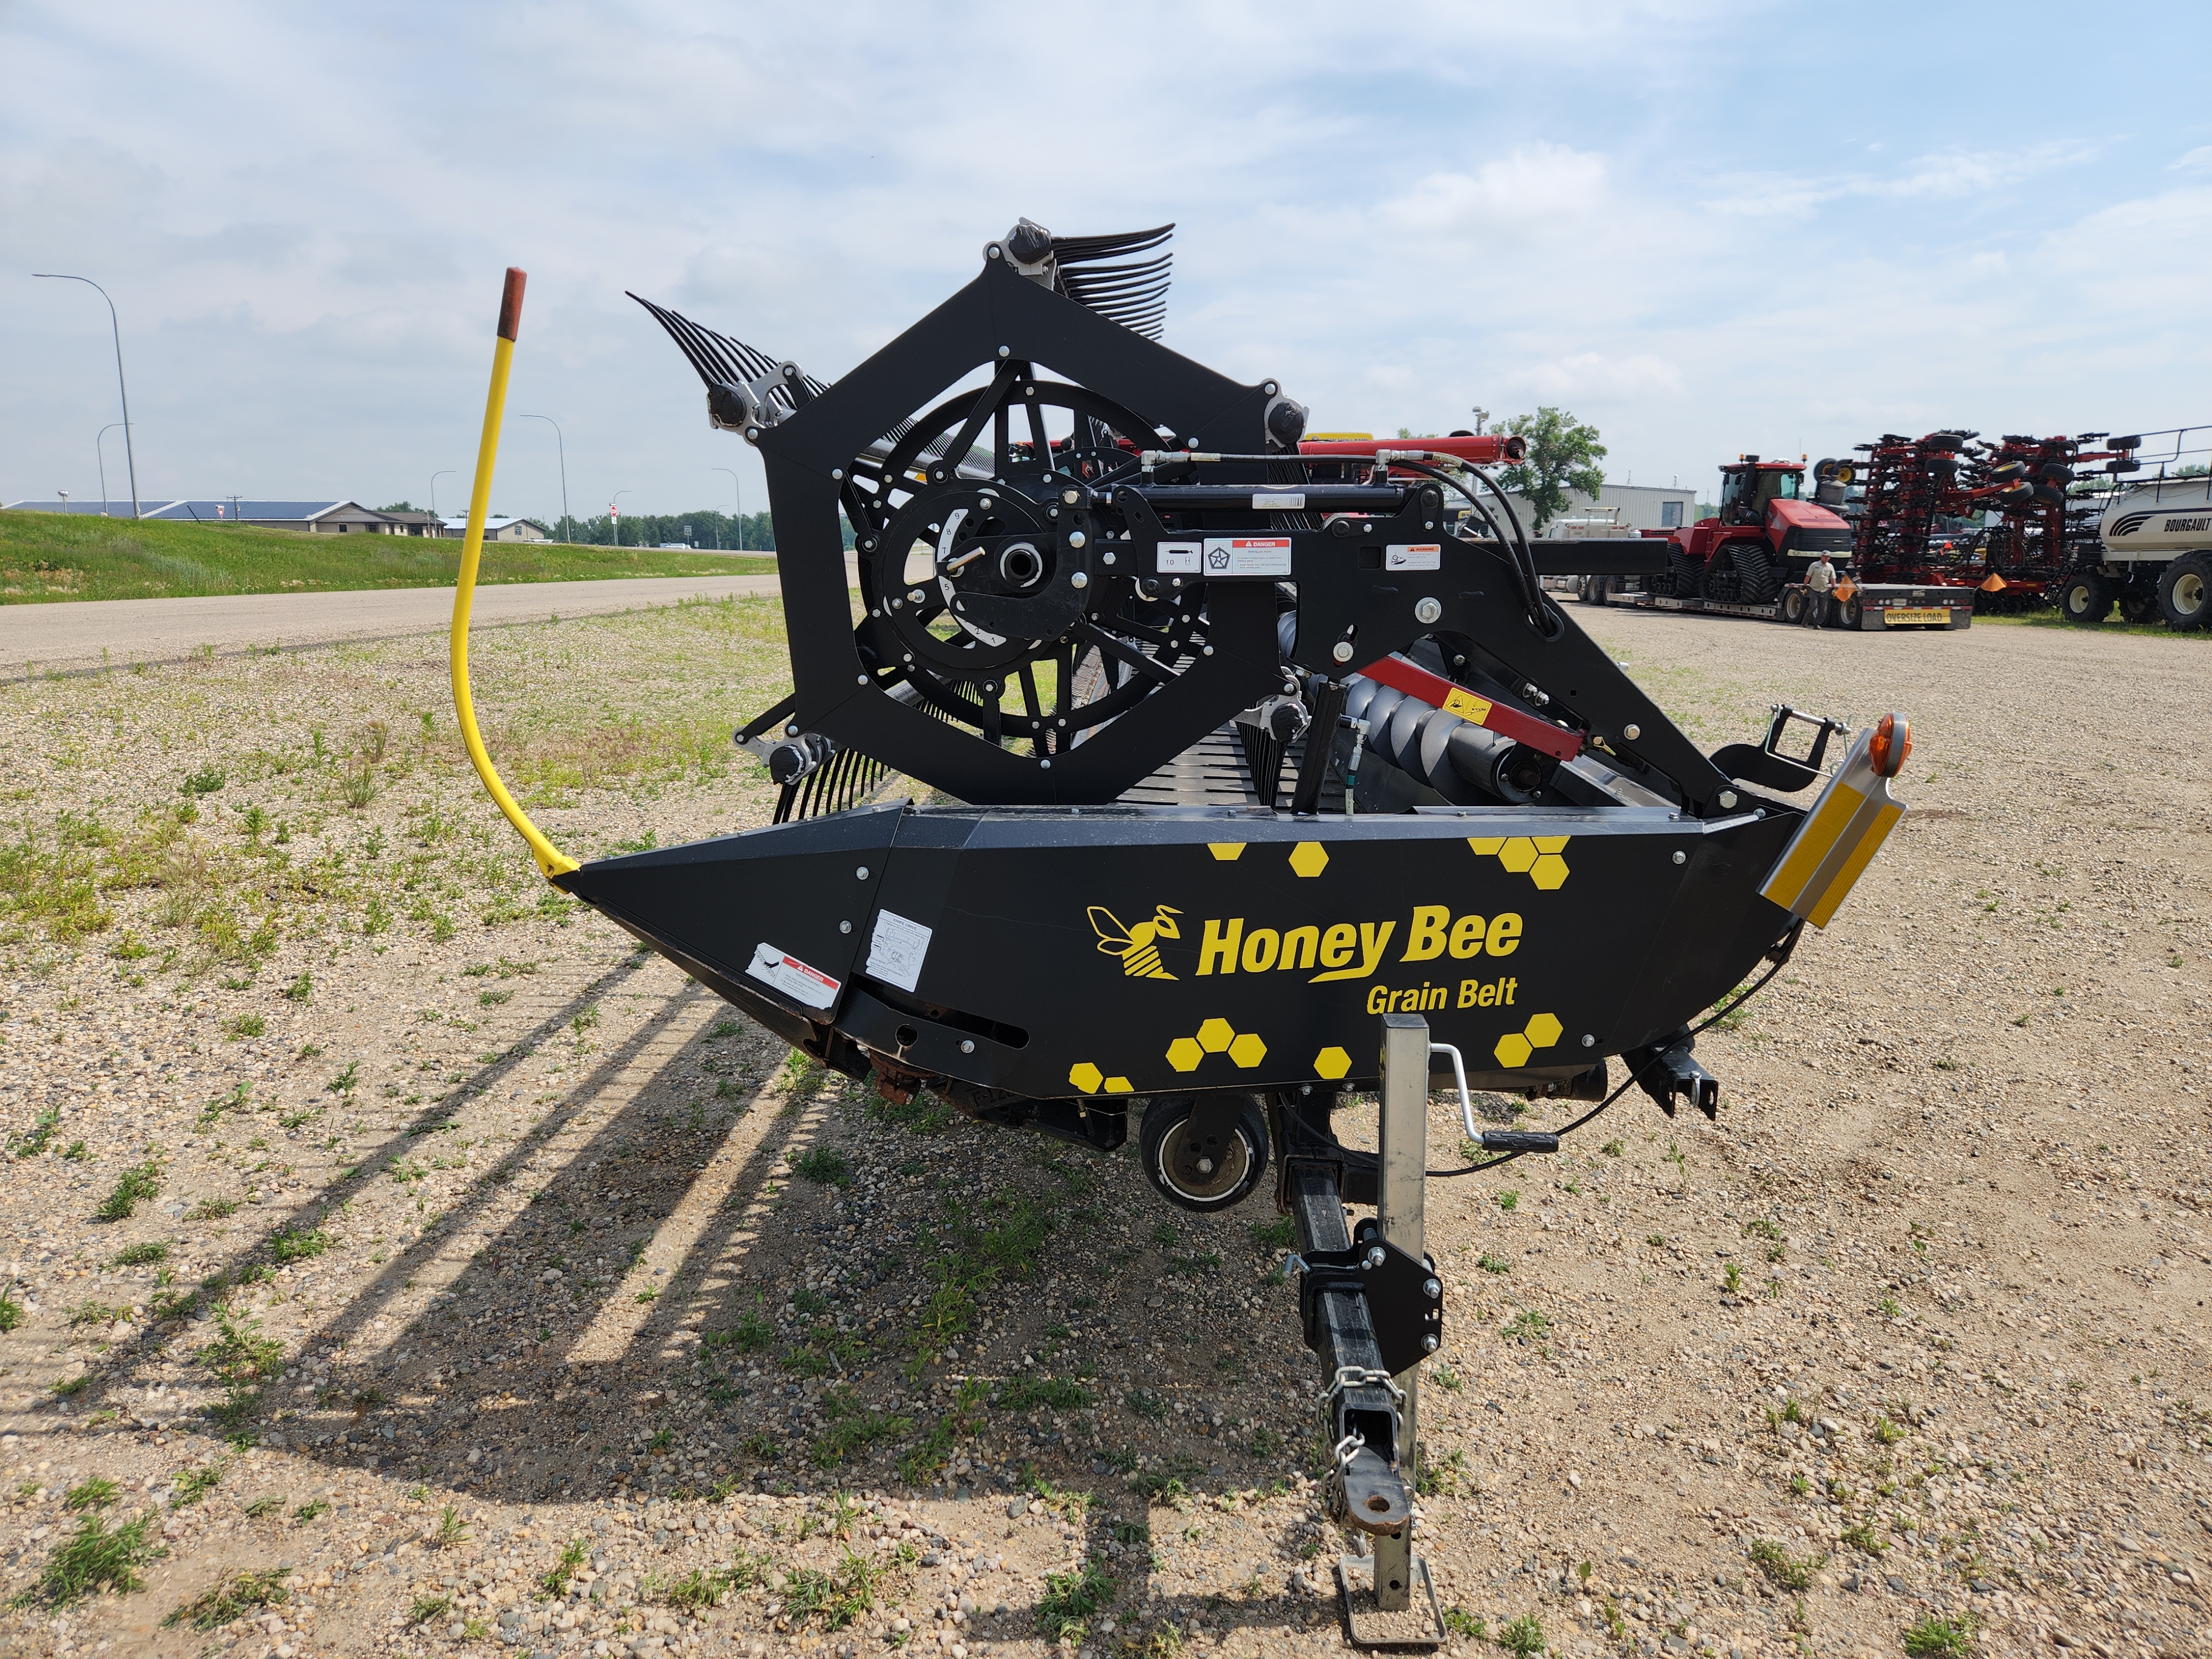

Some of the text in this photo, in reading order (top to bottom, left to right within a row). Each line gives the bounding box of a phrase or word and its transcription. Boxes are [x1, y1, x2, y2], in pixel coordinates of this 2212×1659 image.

[2164, 518, 2211, 532] BOURGAULT
[1886, 612, 1942, 622] OVERSIZE LOAD
[905, 922, 917, 931] DRIVE
[1196, 905, 1523, 983] Honey Bee
[804, 968, 824, 982] DANGER
[1366, 977, 1518, 1015] Grain Belt
